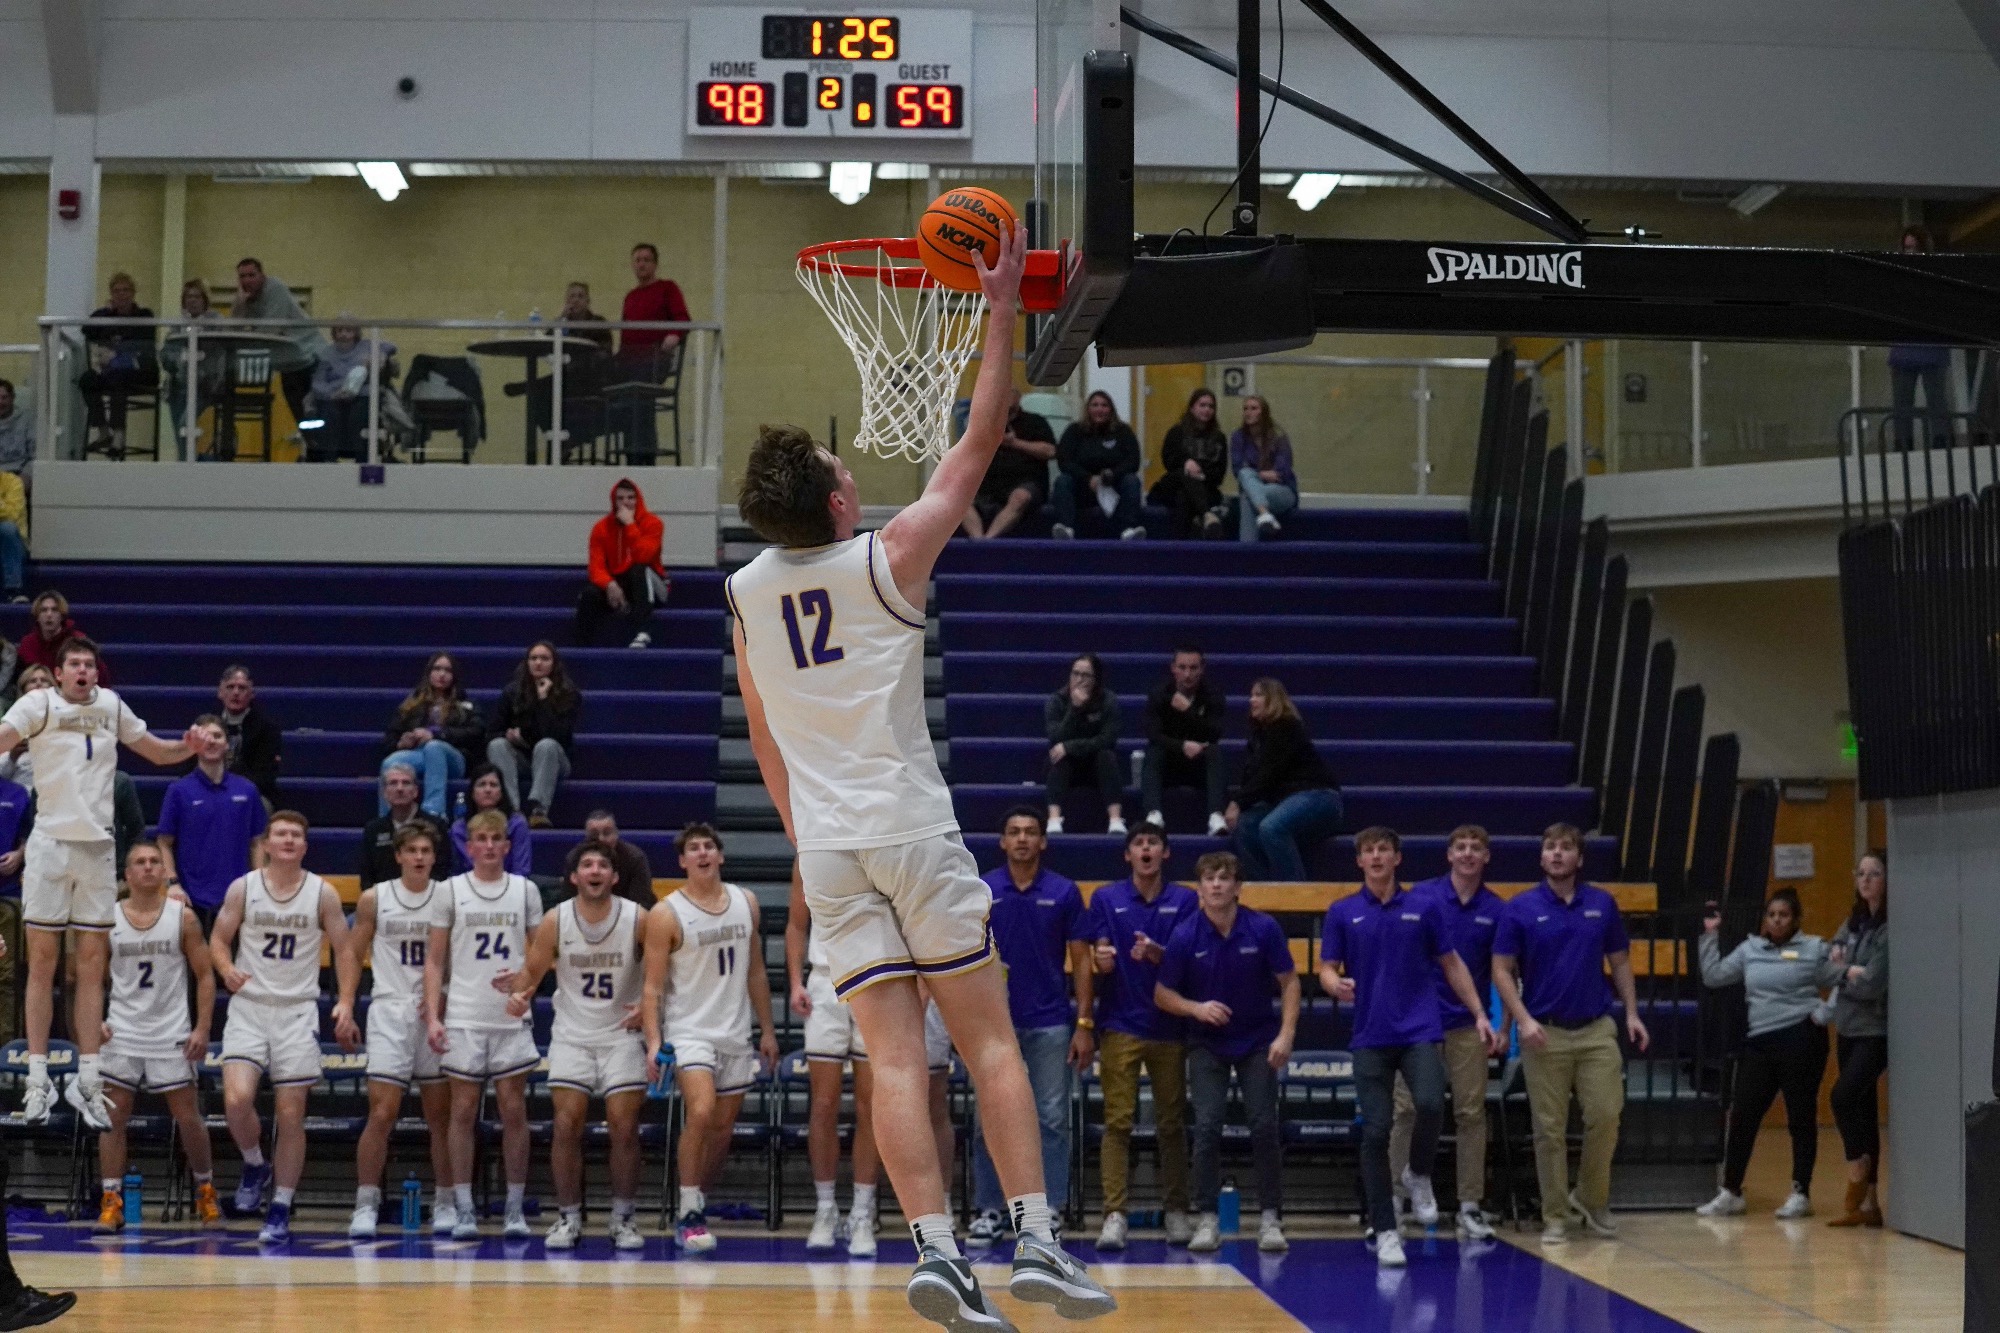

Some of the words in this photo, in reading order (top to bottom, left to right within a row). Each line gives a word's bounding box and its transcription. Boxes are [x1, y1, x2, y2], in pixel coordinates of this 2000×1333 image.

[709, 62, 757, 78] HOME
[899, 63, 951, 81] GUEST
[708, 84, 764, 125] 98
[819, 78, 840, 109] 2
[897, 86, 952, 127] 59
[936, 223, 986, 255] NCAA
[1427, 247, 1583, 289] SPALDING
[780, 587, 844, 670] 12
[86, 735, 93, 761] 1
[262, 932, 297, 960] 20
[401, 940, 426, 966] 10
[475, 932, 510, 960] 24
[138, 961, 154, 989] 2
[718, 946, 735, 976] 11
[582, 972, 613, 1000] 25
